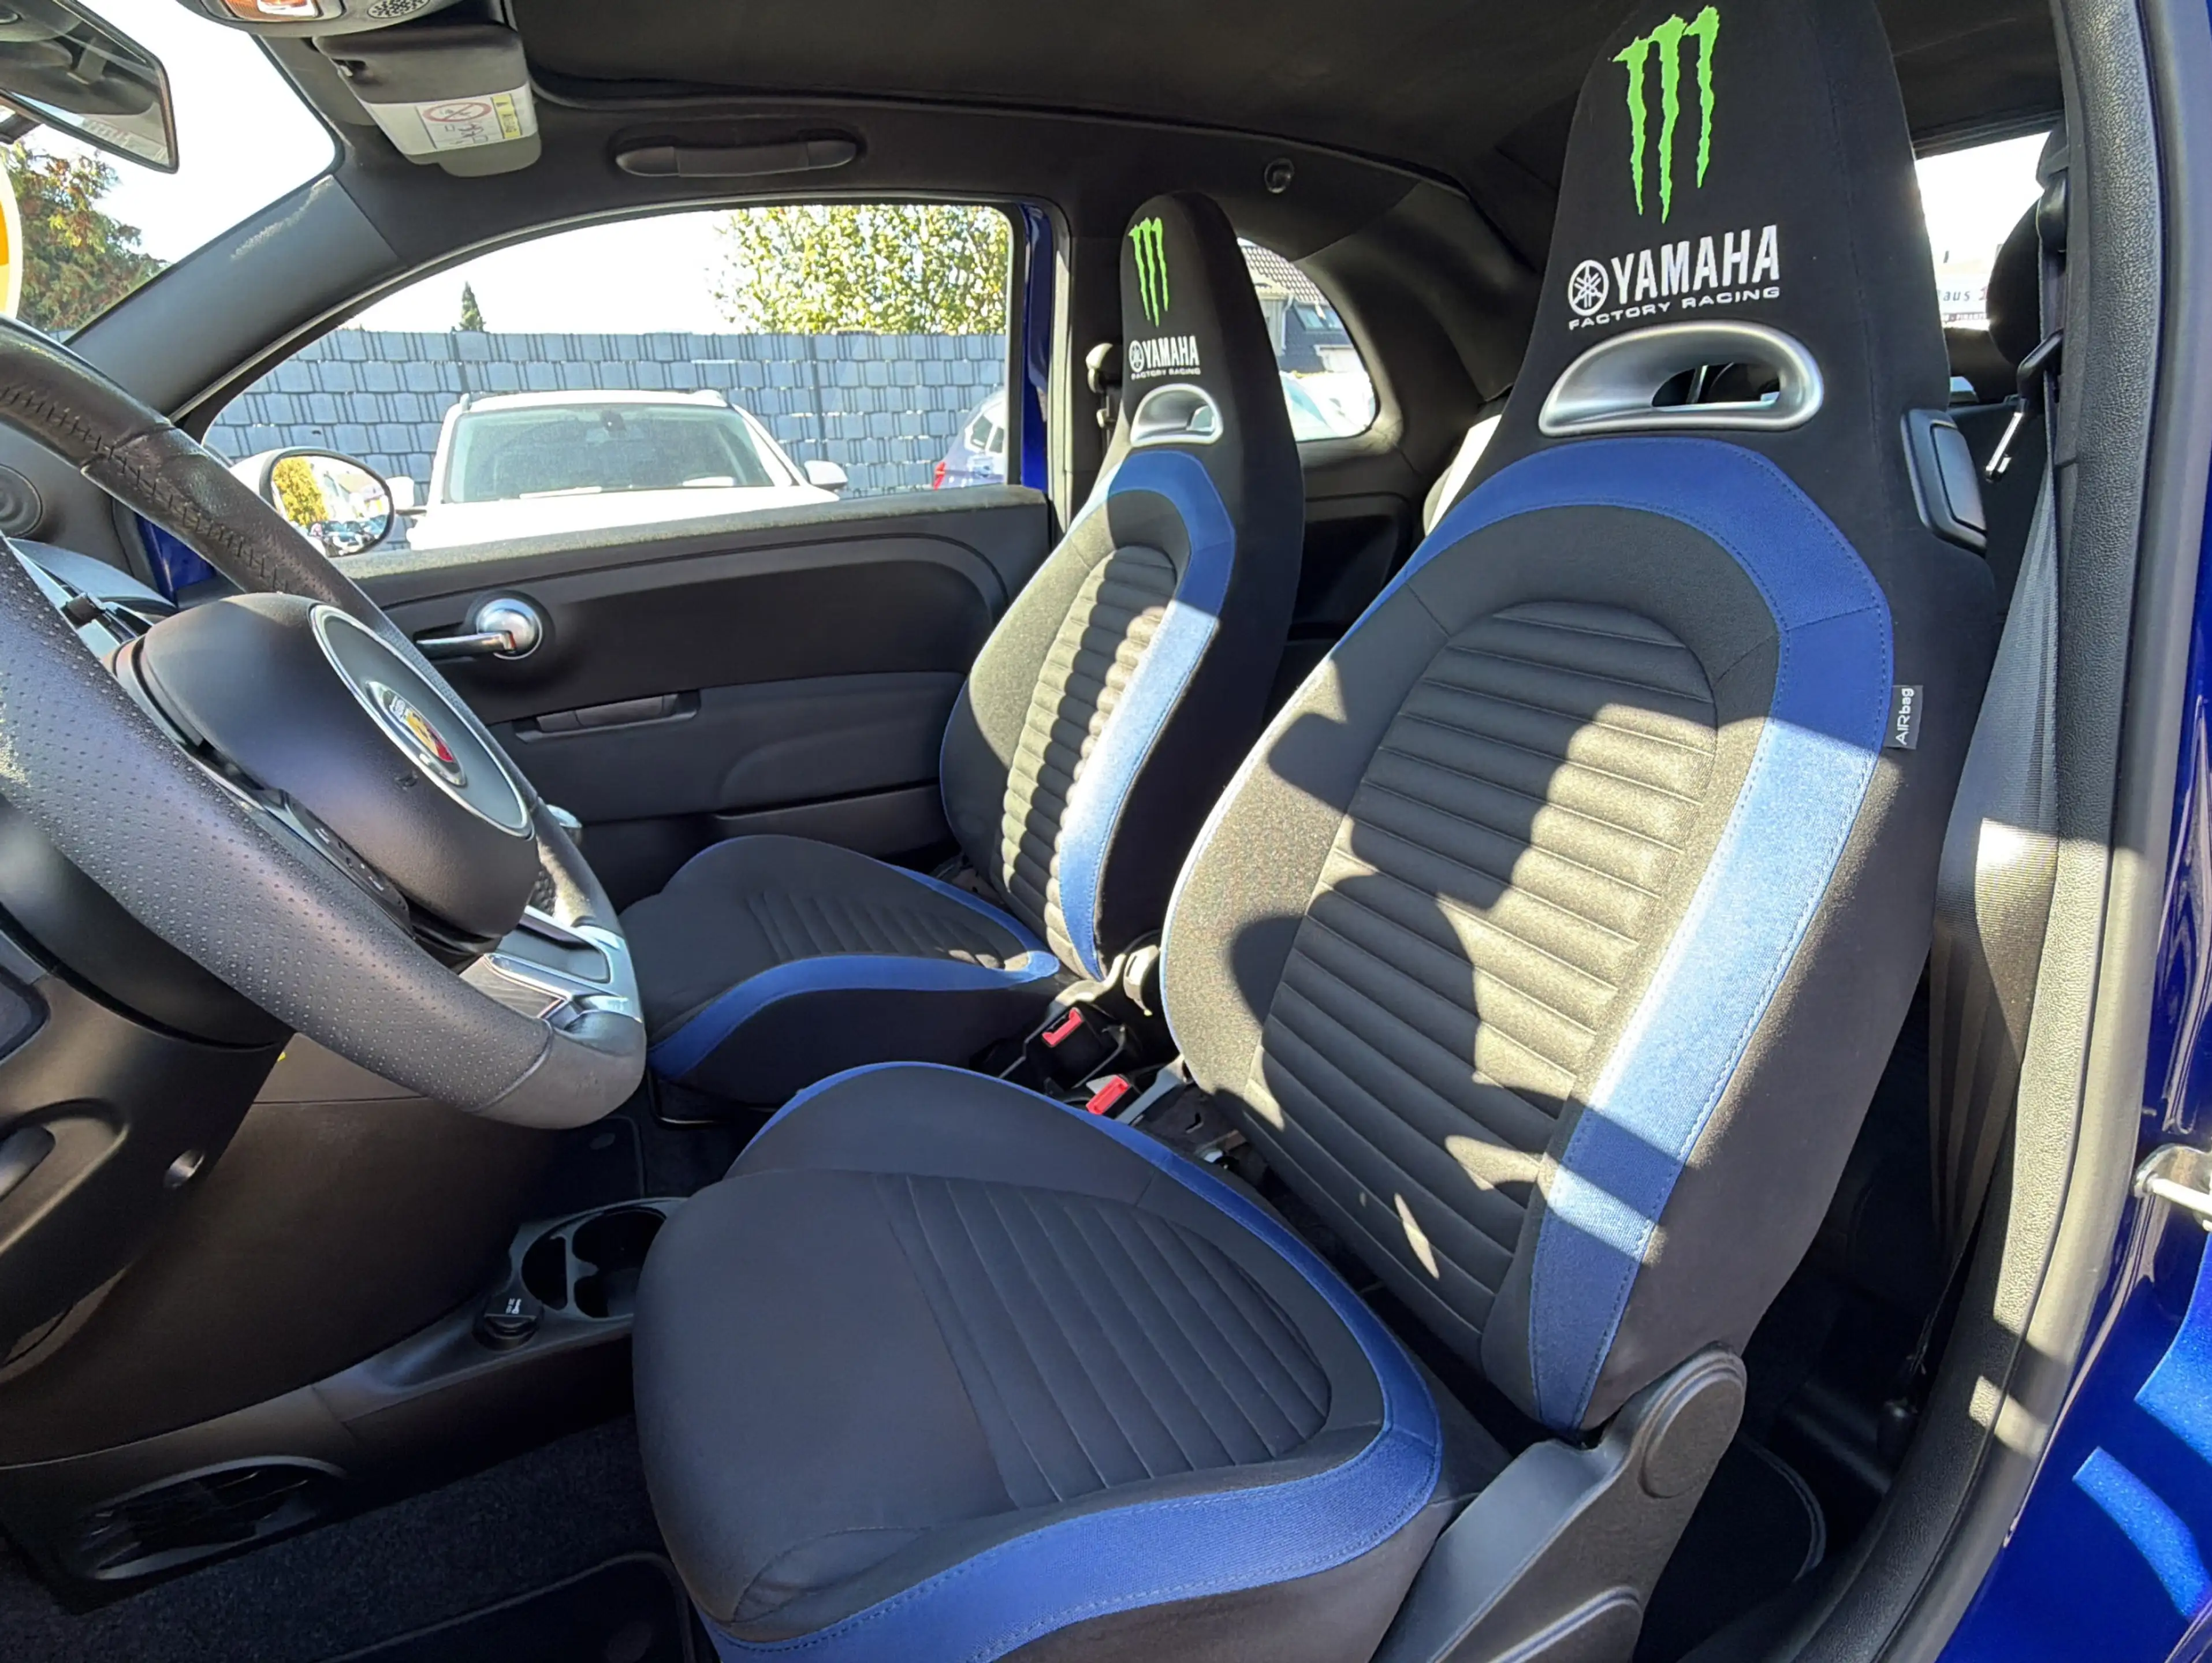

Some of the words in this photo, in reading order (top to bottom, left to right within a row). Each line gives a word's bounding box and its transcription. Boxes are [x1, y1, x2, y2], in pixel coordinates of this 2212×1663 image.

[1611, 225, 1780, 305] YAMAHA
[1569, 301, 1671, 331] FACTORY
[1681, 286, 1781, 309] RACING
[1142, 335, 1200, 368] YAMAHA
[1896, 688, 1915, 745] AIRbag
